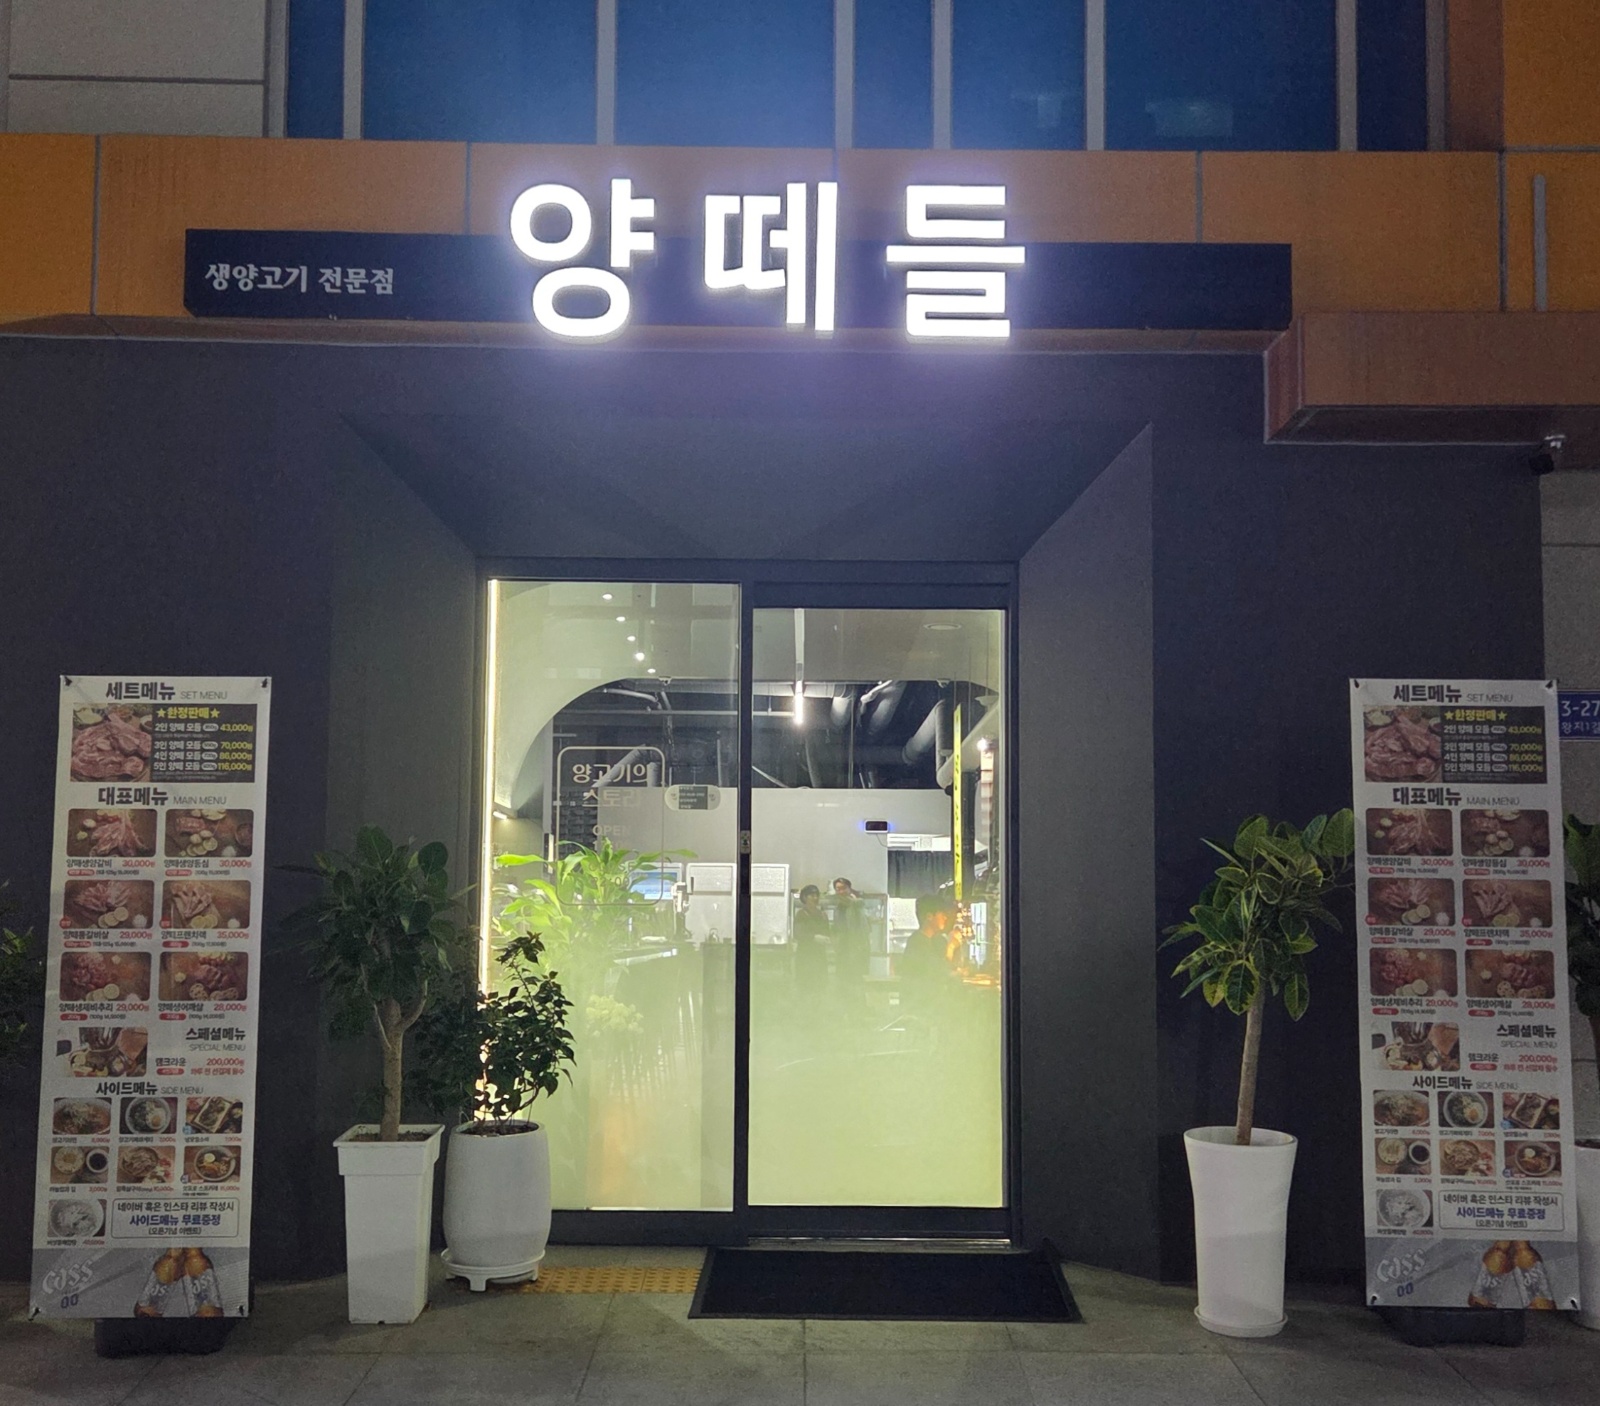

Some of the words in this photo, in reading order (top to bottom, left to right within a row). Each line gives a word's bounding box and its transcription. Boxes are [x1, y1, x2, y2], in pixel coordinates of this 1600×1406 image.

[510, 178, 1026, 338] 양떼들
[204, 262, 308, 293] 생양고기
[318, 266, 394, 295] 전문점
[106, 682, 175, 700] 세트메뉴
[180, 690, 198, 700] SET
[200, 690, 228, 700] MENU
[1393, 684, 1462, 703] 세트메뉴
[1466, 693, 1484, 702] SET
[1486, 693, 1513, 702] MENU
[155, 723, 168, 732] 2인
[1444, 725, 1458, 734] 2인
[154, 741, 167, 750] 3인
[1444, 743, 1458, 752] 3인
[154, 751, 167, 760] 4인
[1444, 753, 1458, 762] 4인
[153, 762, 167, 771] 5인
[1444, 763, 1458, 772] 5인
[573, 763, 648, 784] 양고기의
[98, 787, 169, 805] 대표메뉴
[173, 796, 198, 804] MAIN
[200, 796, 227, 804] MENU
[582, 788, 641, 808] 스토리
[1393, 787, 1462, 806] 대표메뉴
[1467, 797, 1490, 805] MAIN
[1492, 797, 1520, 805] MENU
[593, 824, 632, 836] OPEN
[185, 1027, 246, 1041] 스페셜메뉴
[1497, 1024, 1557, 1039] 스페셜메뉴
[188, 1043, 220, 1051] SPECIAL
[222, 1043, 246, 1051] MENU
[1500, 1040, 1531, 1048] SPECIAL
[1533, 1040, 1558, 1049] MENU
[1412, 1075, 1473, 1090] 사이드메뉴
[1476, 1082, 1494, 1090] SIDE
[1495, 1082, 1519, 1090] MENU
[96, 1082, 158, 1096] 사이드메뉴
[160, 1086, 178, 1094] SIDE
[180, 1086, 204, 1094] MENU
[117, 1202, 143, 1212] 네이버
[145, 1202, 161, 1212] 혹은
[164, 1202, 189, 1212] 인스타
[191, 1201, 208, 1212] 리뷰
[210, 1201, 234, 1212] 작성시
[1443, 1194, 1468, 1204] 네이버
[1470, 1195, 1486, 1205] 혹은
[1488, 1195, 1513, 1205] 인스타
[1515, 1195, 1531, 1206] 리뷰
[1533, 1196, 1558, 1207] 작성시
[1456, 1207, 1505, 1218] 사이드메뉴
[1507, 1208, 1546, 1219] 무료증정
[129, 1214, 178, 1226] 사이드메뉴
[182, 1214, 221, 1226] 무료증정
[1475, 1219, 1504, 1228] (오픈기념
[1506, 1220, 1528, 1229] 이벤트)
[148, 1226, 177, 1235] (오픈기념
[179, 1227, 202, 1235] 이벤트)
[1376, 1248, 1428, 1283] Cass
[42, 1258, 94, 1295] Cass
